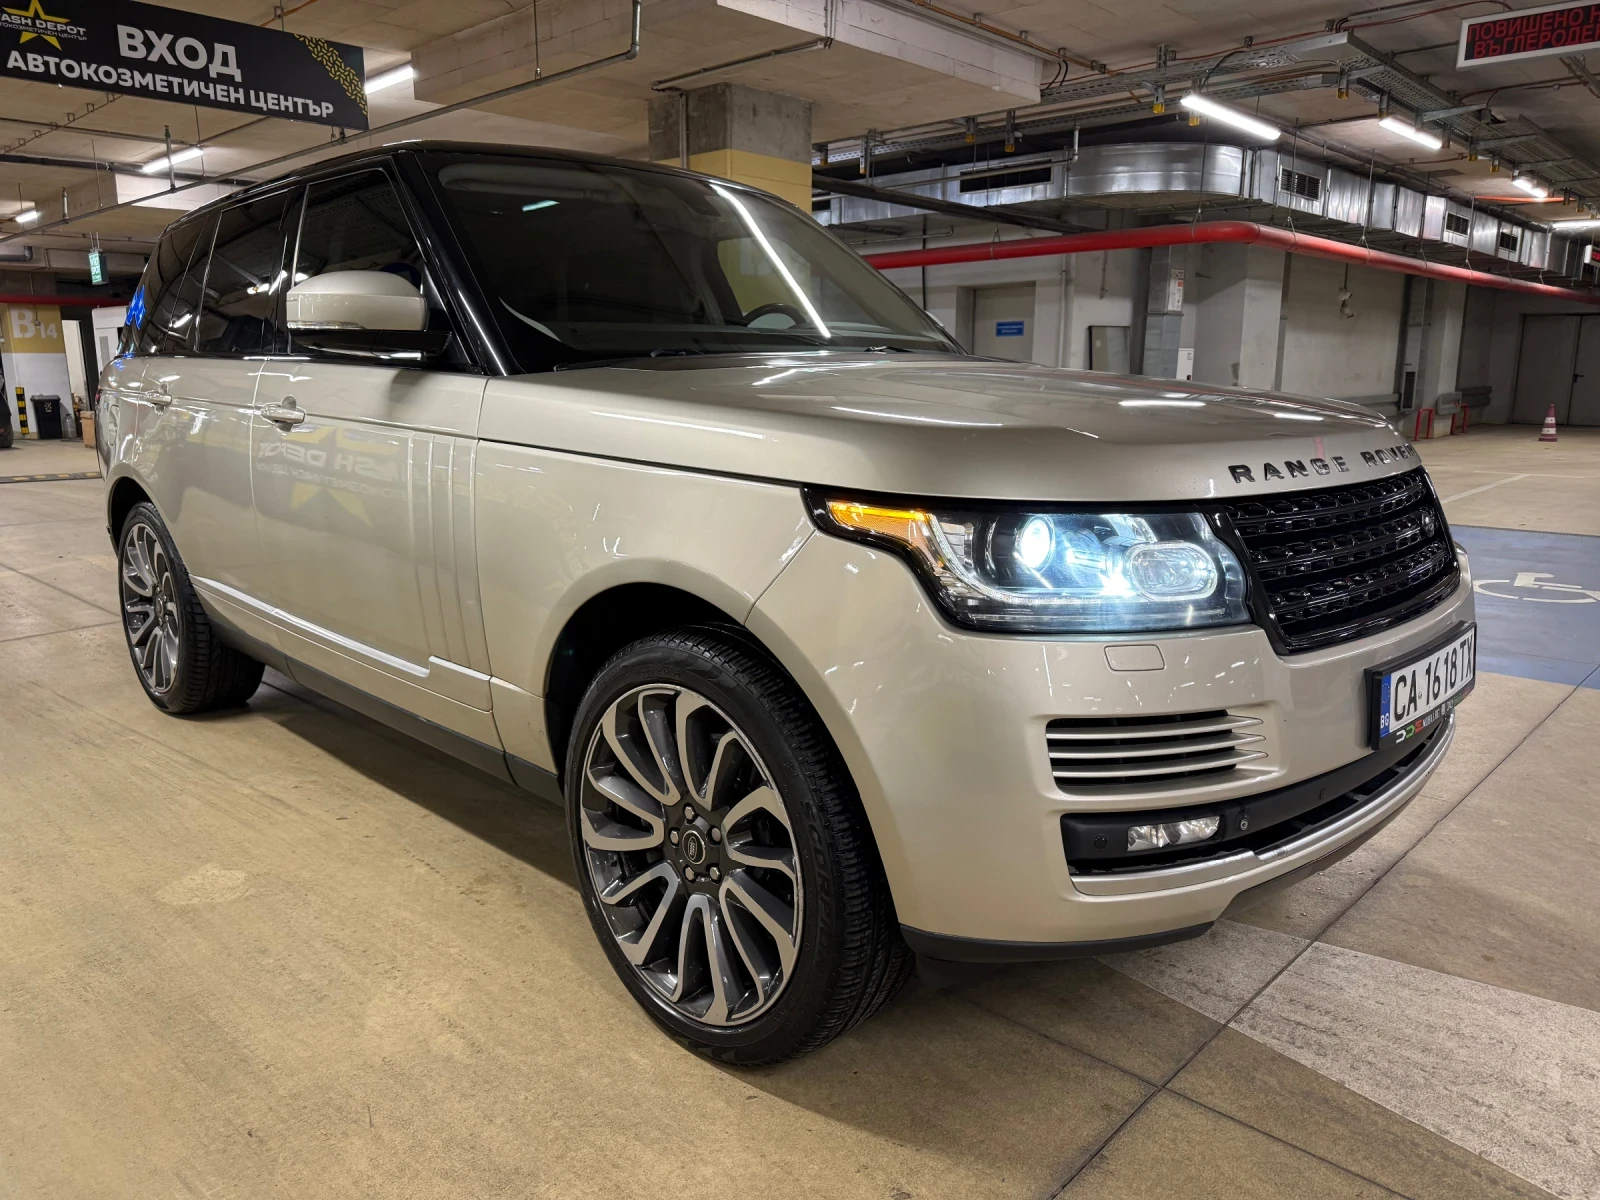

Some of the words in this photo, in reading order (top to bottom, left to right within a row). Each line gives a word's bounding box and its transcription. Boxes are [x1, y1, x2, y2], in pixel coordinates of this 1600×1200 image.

[0, 13, 32, 26] ASH
[36, 19, 87, 36] DEPOT
[1467, 8, 1584, 42] ПОВИШЕНО
[116, 24, 242, 82] ВХОД
[7, 51, 246, 105] АВТОКОЗМЕТИЧЕН
[250, 90, 334, 118] ЦЕНТЪР
[1228, 455, 1349, 484] RANGE
[1380, 713, 1390, 730] BG
